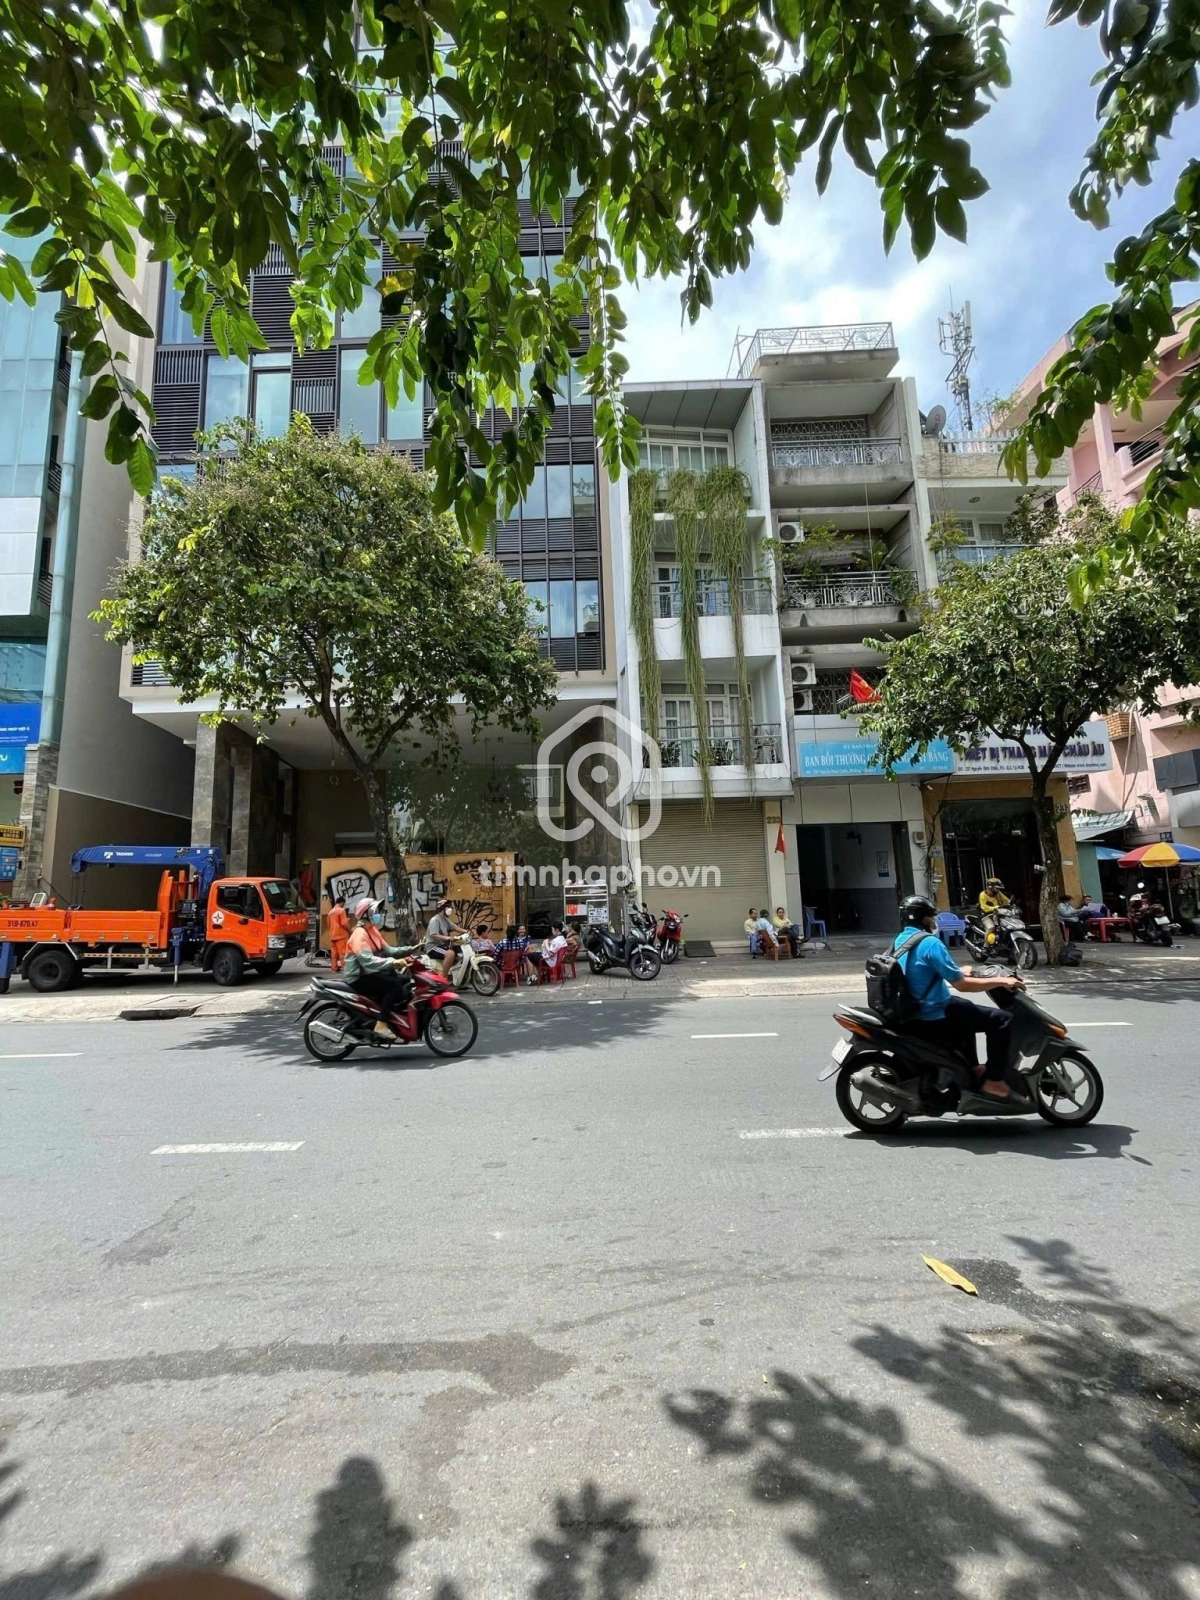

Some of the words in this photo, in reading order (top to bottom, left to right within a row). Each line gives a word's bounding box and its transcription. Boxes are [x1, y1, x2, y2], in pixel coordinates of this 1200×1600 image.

[805, 755, 819, 767] BAN
[820, 750, 834, 766] BỒI
[834, 752, 866, 766] THƯỜNG
